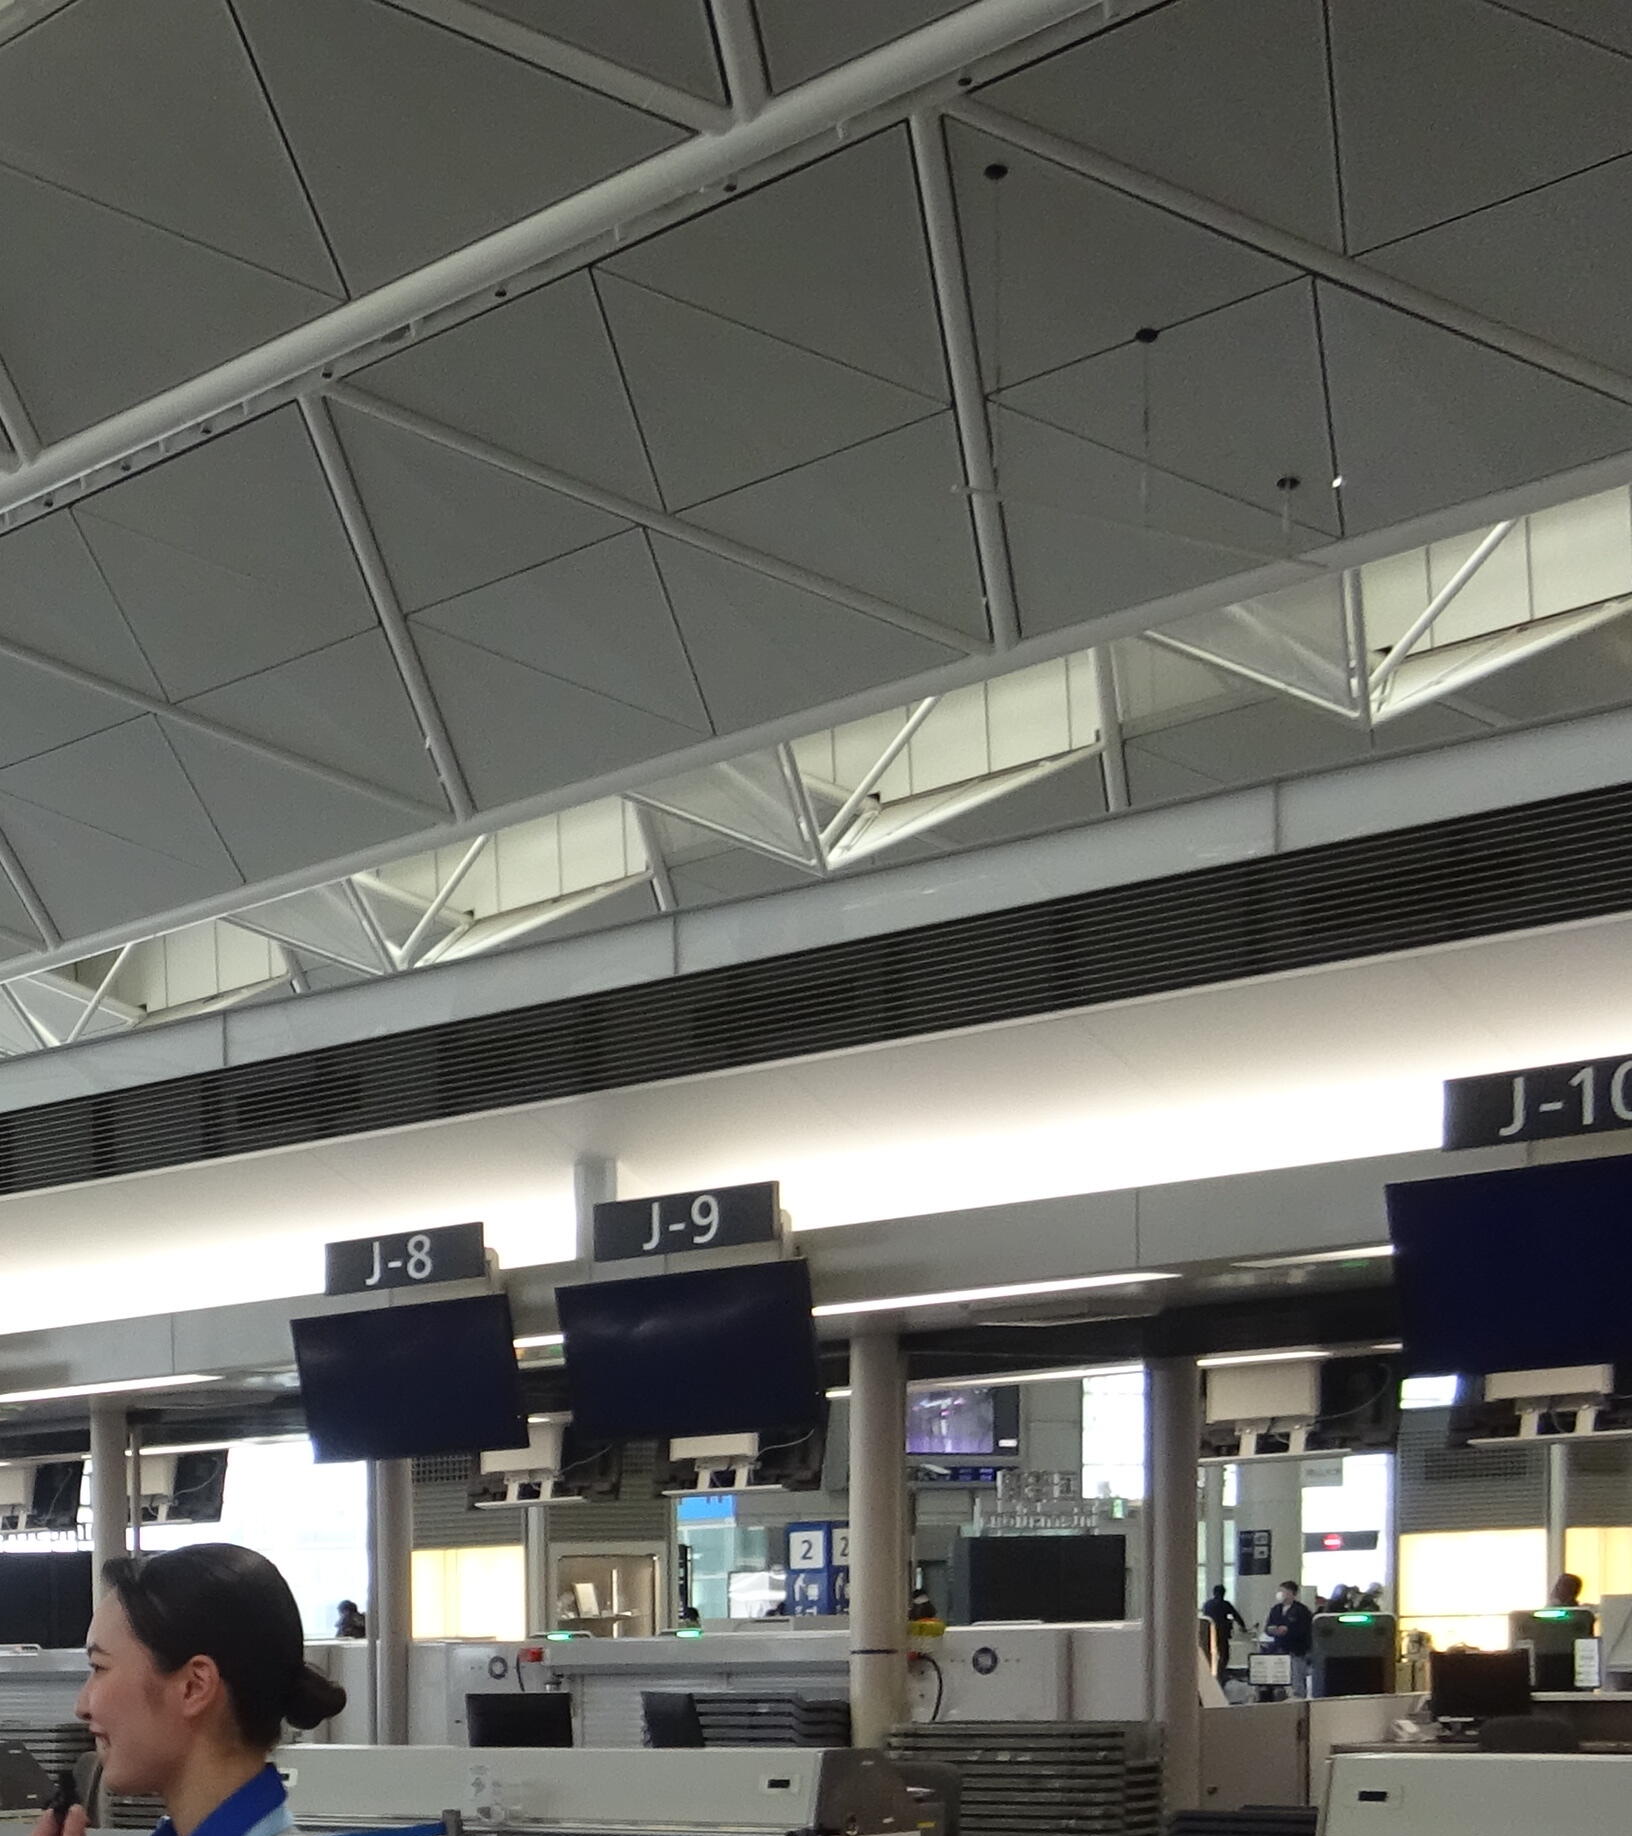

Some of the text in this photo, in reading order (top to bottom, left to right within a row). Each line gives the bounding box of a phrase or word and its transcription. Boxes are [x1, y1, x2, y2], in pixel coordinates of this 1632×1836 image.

[642, 1194, 720, 1251] J-9
[364, 1233, 433, 1286] J-8
[800, 1539, 813, 1560] 2
